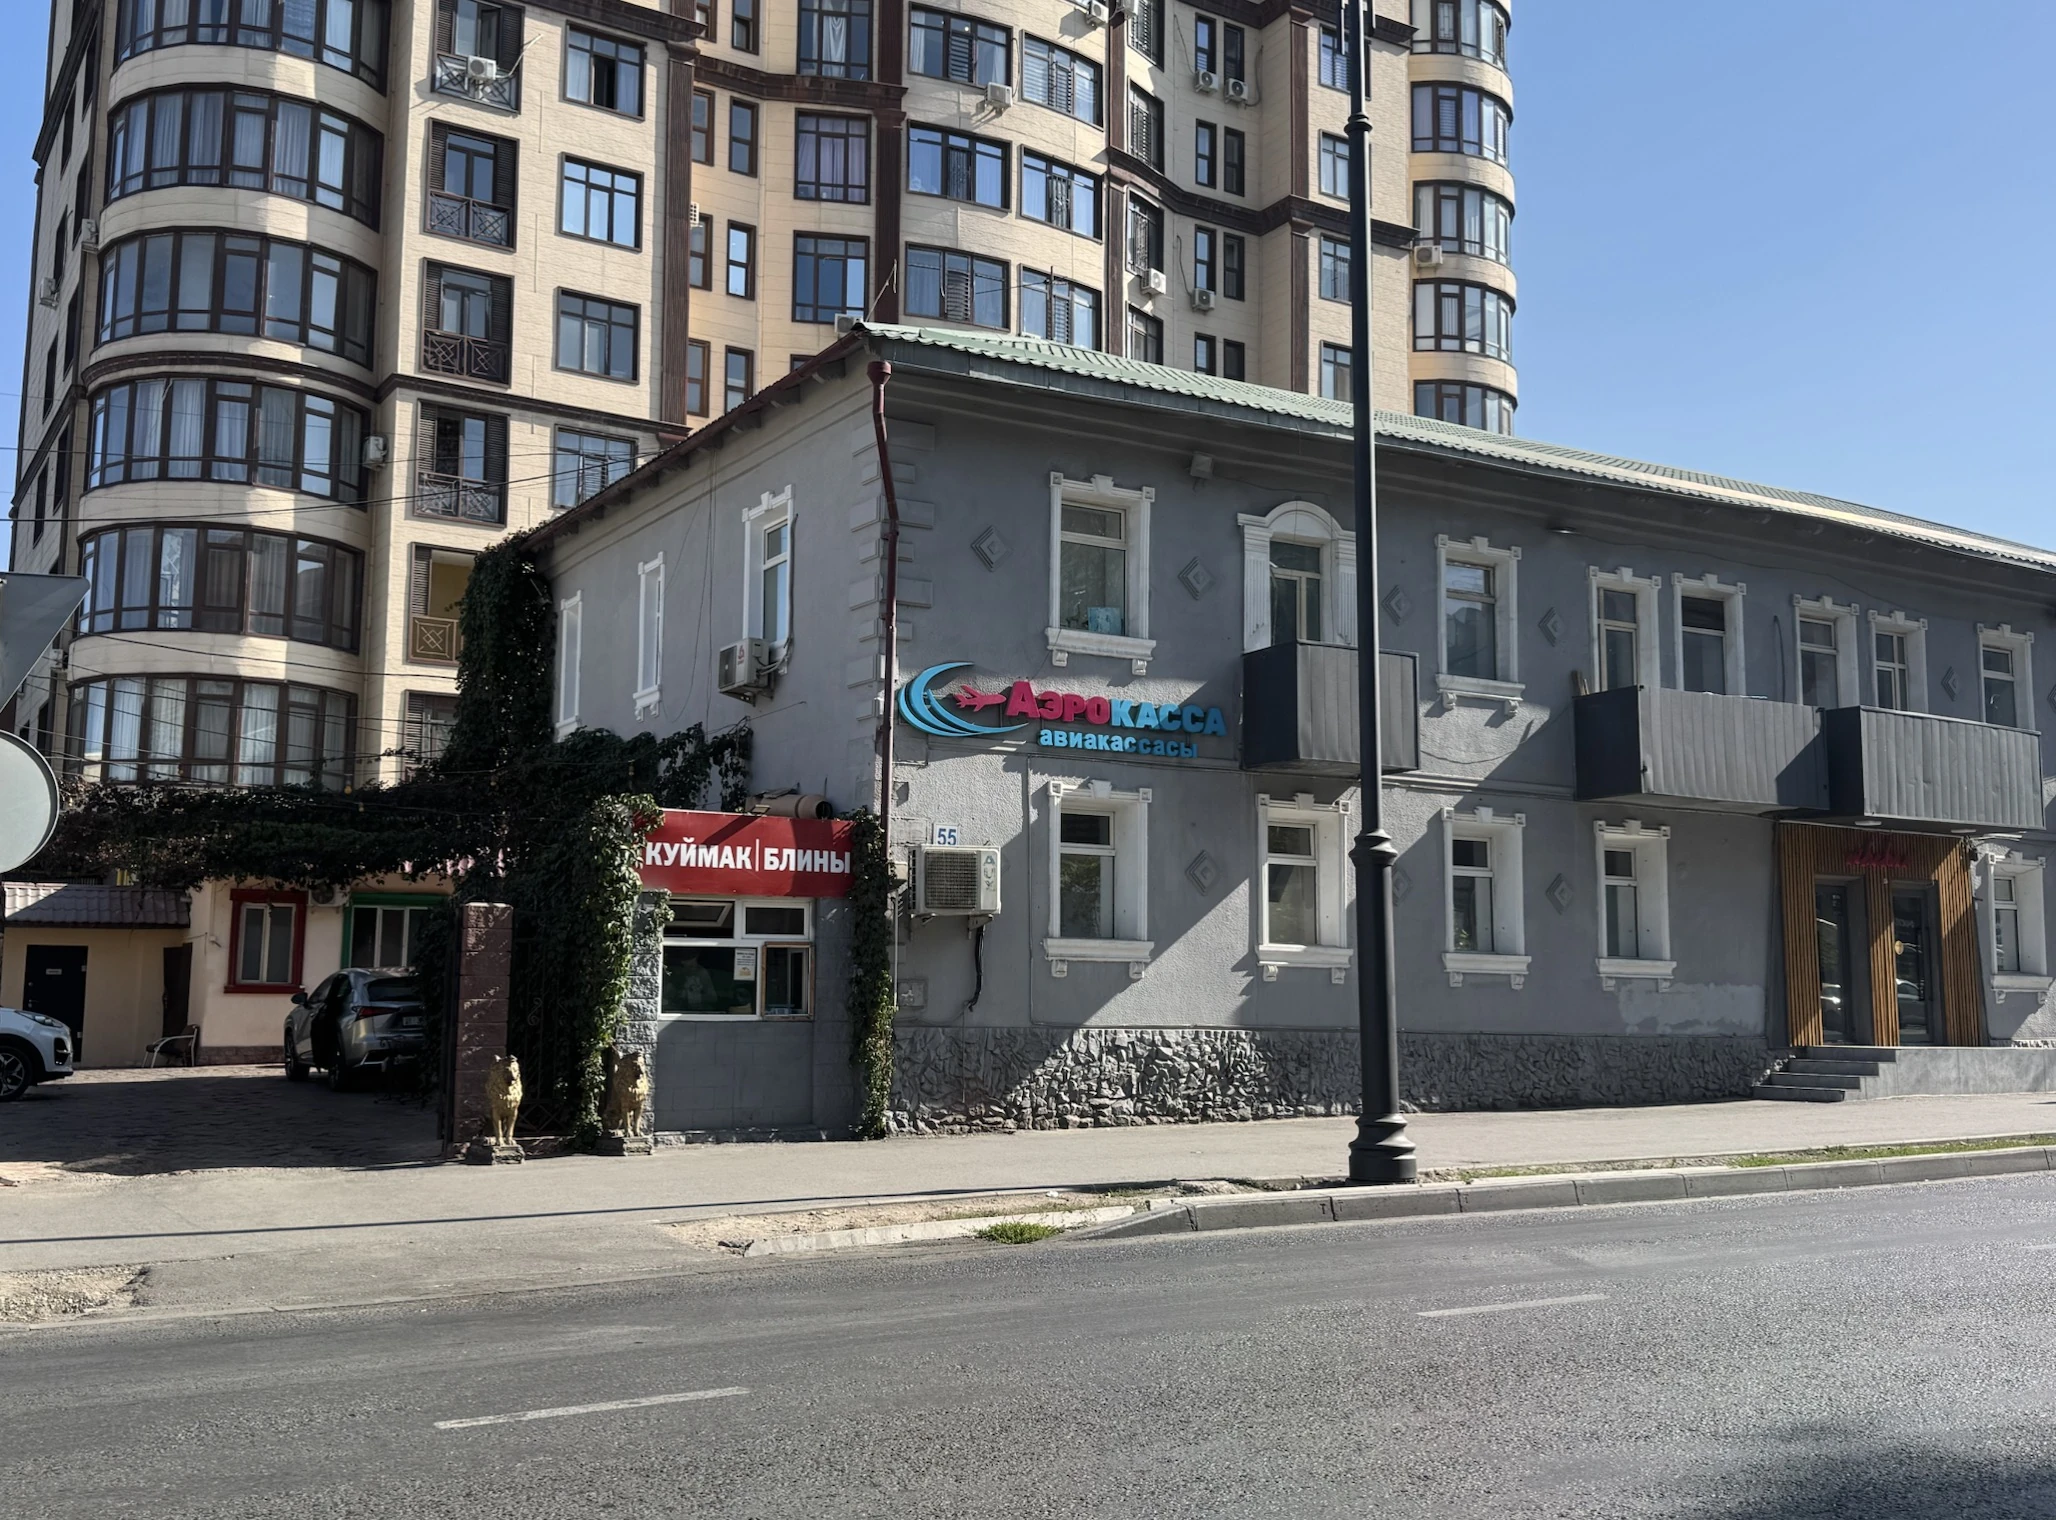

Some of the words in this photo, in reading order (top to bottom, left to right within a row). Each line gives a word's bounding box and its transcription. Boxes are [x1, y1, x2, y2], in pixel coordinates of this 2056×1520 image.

[1039, 729, 1198, 758] авиакассасы
[937, 828, 957, 846] 55
[645, 837, 752, 870] КУЙМАК
[764, 847, 850, 874] БЛИНЫ
